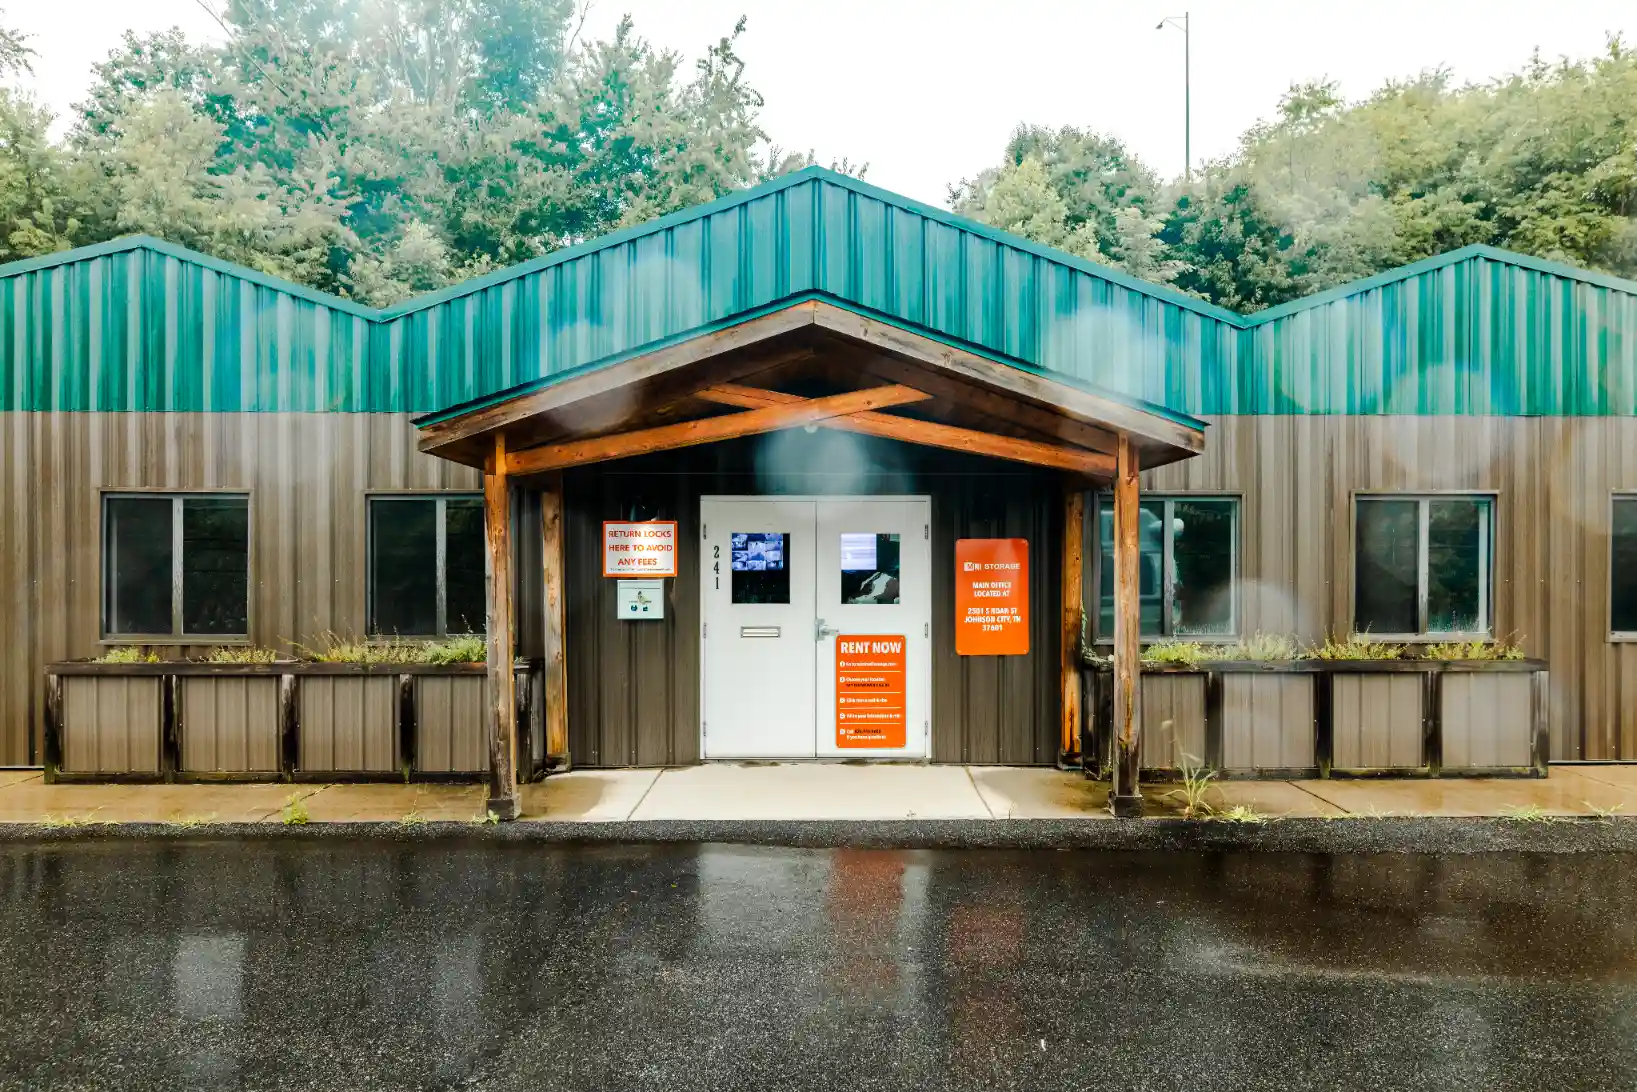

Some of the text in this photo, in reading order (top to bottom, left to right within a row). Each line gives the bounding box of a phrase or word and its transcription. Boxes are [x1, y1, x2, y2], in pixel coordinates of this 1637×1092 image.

[608, 530, 672, 538] RETURN LOCKS
[972, 581, 1012, 589] MAIN OFFICE
[964, 615, 996, 623] JOHNSON
[1012, 615, 1021, 623] TN
[982, 624, 1003, 632] 37601
[840, 641, 902, 654] RENT NOW
